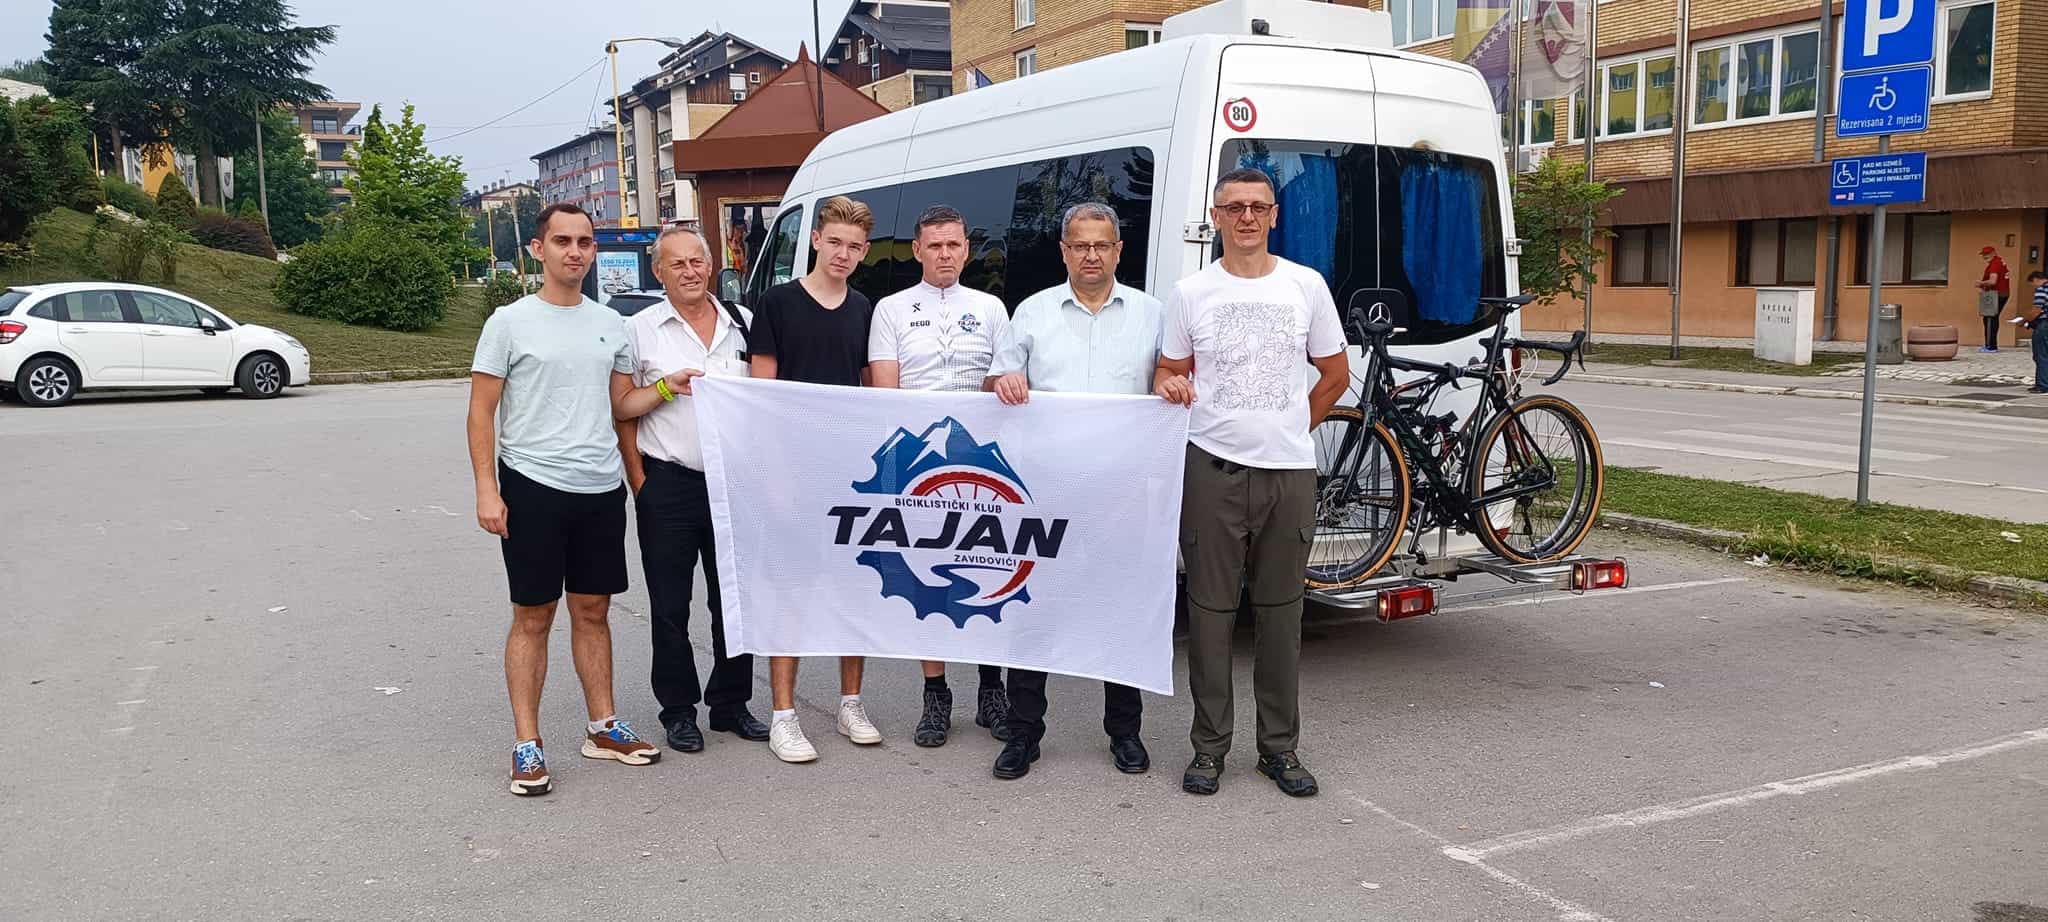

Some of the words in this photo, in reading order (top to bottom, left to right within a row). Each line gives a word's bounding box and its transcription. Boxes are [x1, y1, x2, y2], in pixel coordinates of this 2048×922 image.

[1863, 0, 1914, 57] P
[1232, 105, 1249, 122] 80
[1840, 117, 1884, 129] Rezervisana
[1887, 114, 1893, 126] 2
[1896, 112, 1922, 128] mjesta
[1862, 168, 1886, 176] PARKING
[895, 497, 969, 511] BICIKLISTIČKI
[974, 502, 1002, 514] KLUB
[827, 506, 1069, 559] TAJAN
